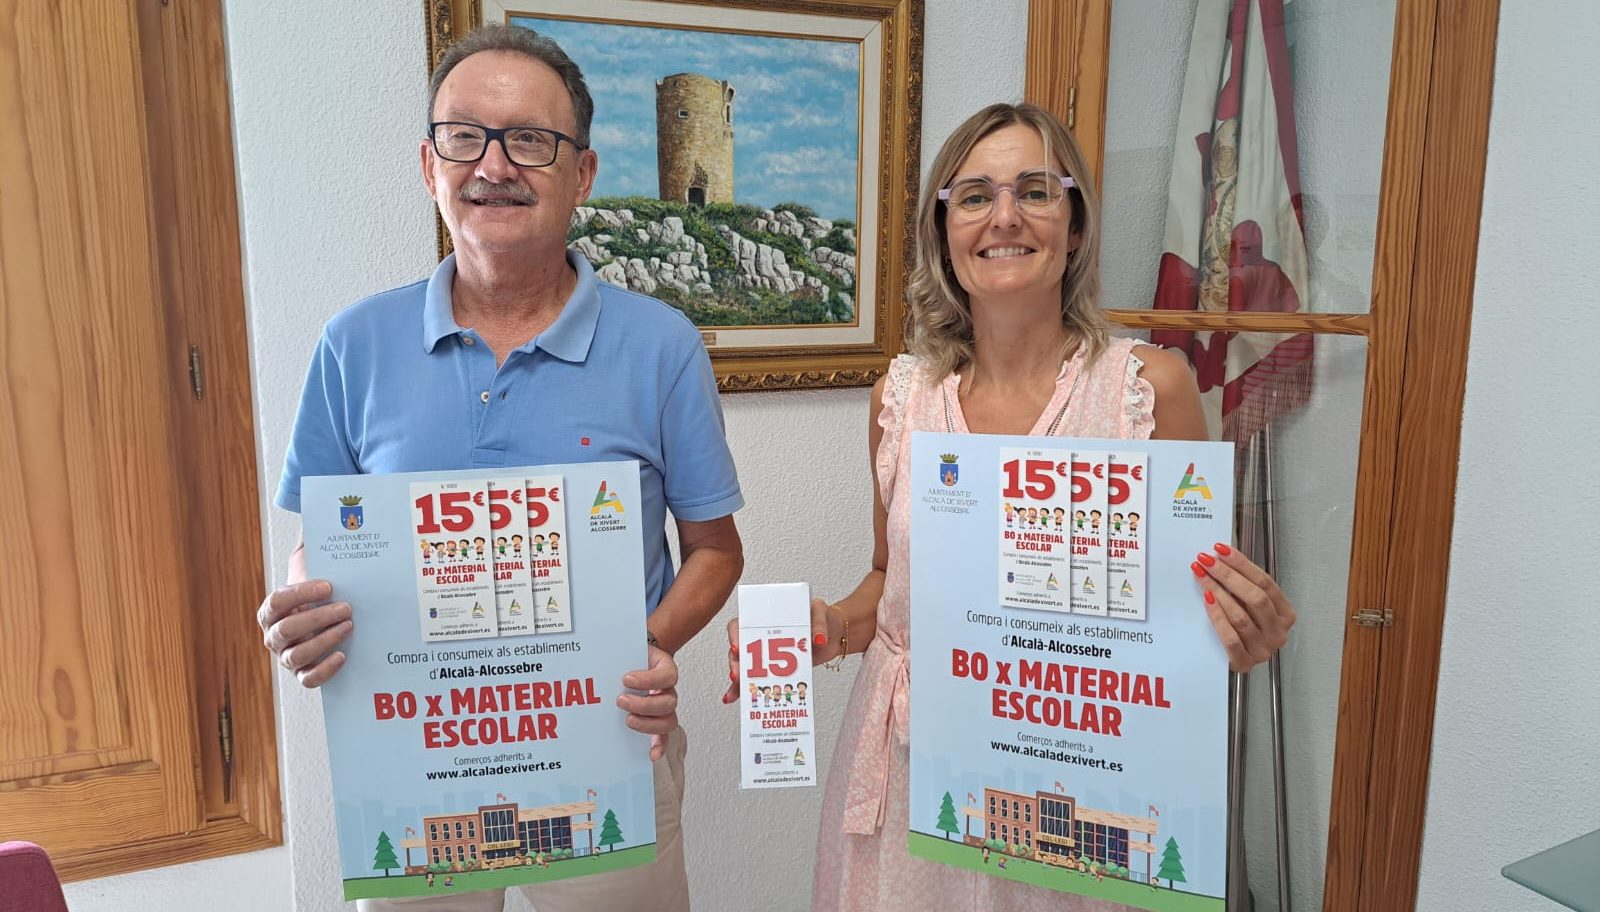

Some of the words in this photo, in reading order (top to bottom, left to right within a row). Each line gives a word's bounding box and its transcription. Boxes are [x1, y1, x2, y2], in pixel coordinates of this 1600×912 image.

[1003, 459, 1067, 500] 15€
[1071, 462, 1104, 503] 5€
[1108, 464, 1142, 505] 5€
[415, 491, 485, 534] 15€
[488, 489, 522, 530] 5€
[526, 487, 560, 528] 5€
[1004, 531, 1015, 540] BO
[1024, 532, 1065, 544] MATERIAL
[1016, 541, 1052, 552] ESCOLAR
[1070, 536, 1101, 547] TERIAL
[1108, 539, 1139, 550] TERIAL
[531, 558, 562, 569] TERIAL
[1108, 549, 1126, 558] LAR
[422, 567, 435, 577] BO
[444, 564, 488, 575] MATERIAL
[494, 561, 525, 572] TERIAL
[494, 571, 513, 581] LAR
[531, 568, 550, 578] LAR
[436, 573, 475, 585] ESCOLAR
[967, 610, 1002, 626] Compra
[1010, 616, 1063, 634] consumeix
[1066, 621, 1081, 636] als
[1084, 624, 1153, 644] establiments
[387, 652, 429, 666] Compra
[437, 646, 494, 662] consumeix
[496, 646, 511, 658] als
[514, 640, 580, 657] establiments
[1002, 634, 1112, 659] d'Alcalà-Alcossebre
[746, 637, 808, 678] 15€
[429, 661, 542, 680] d'Alcalà-Alcossebre
[952, 648, 988, 681] BO
[995, 661, 1011, 685] x
[1019, 659, 1171, 709] MATERIAL
[374, 691, 417, 720] BO
[425, 695, 444, 717] x
[450, 677, 601, 716] MATERIAL
[750, 711, 761, 720] BO
[770, 709, 808, 718] MATERIAL
[992, 688, 1122, 737] ESCOLAR
[423, 713, 558, 749] ESCOLAR
[762, 719, 797, 729] ESCOLAR
[1017, 731, 1053, 747] Comerços
[1054, 737, 1086, 752] adherits
[1088, 745, 1093, 753] a
[454, 754, 492, 767] Comerços
[494, 752, 525, 764] adherits
[527, 753, 532, 761] a
[991, 740, 1123, 772] www.alcaladexivert.es
[426, 760, 562, 781] www.alcaladexivert.es
